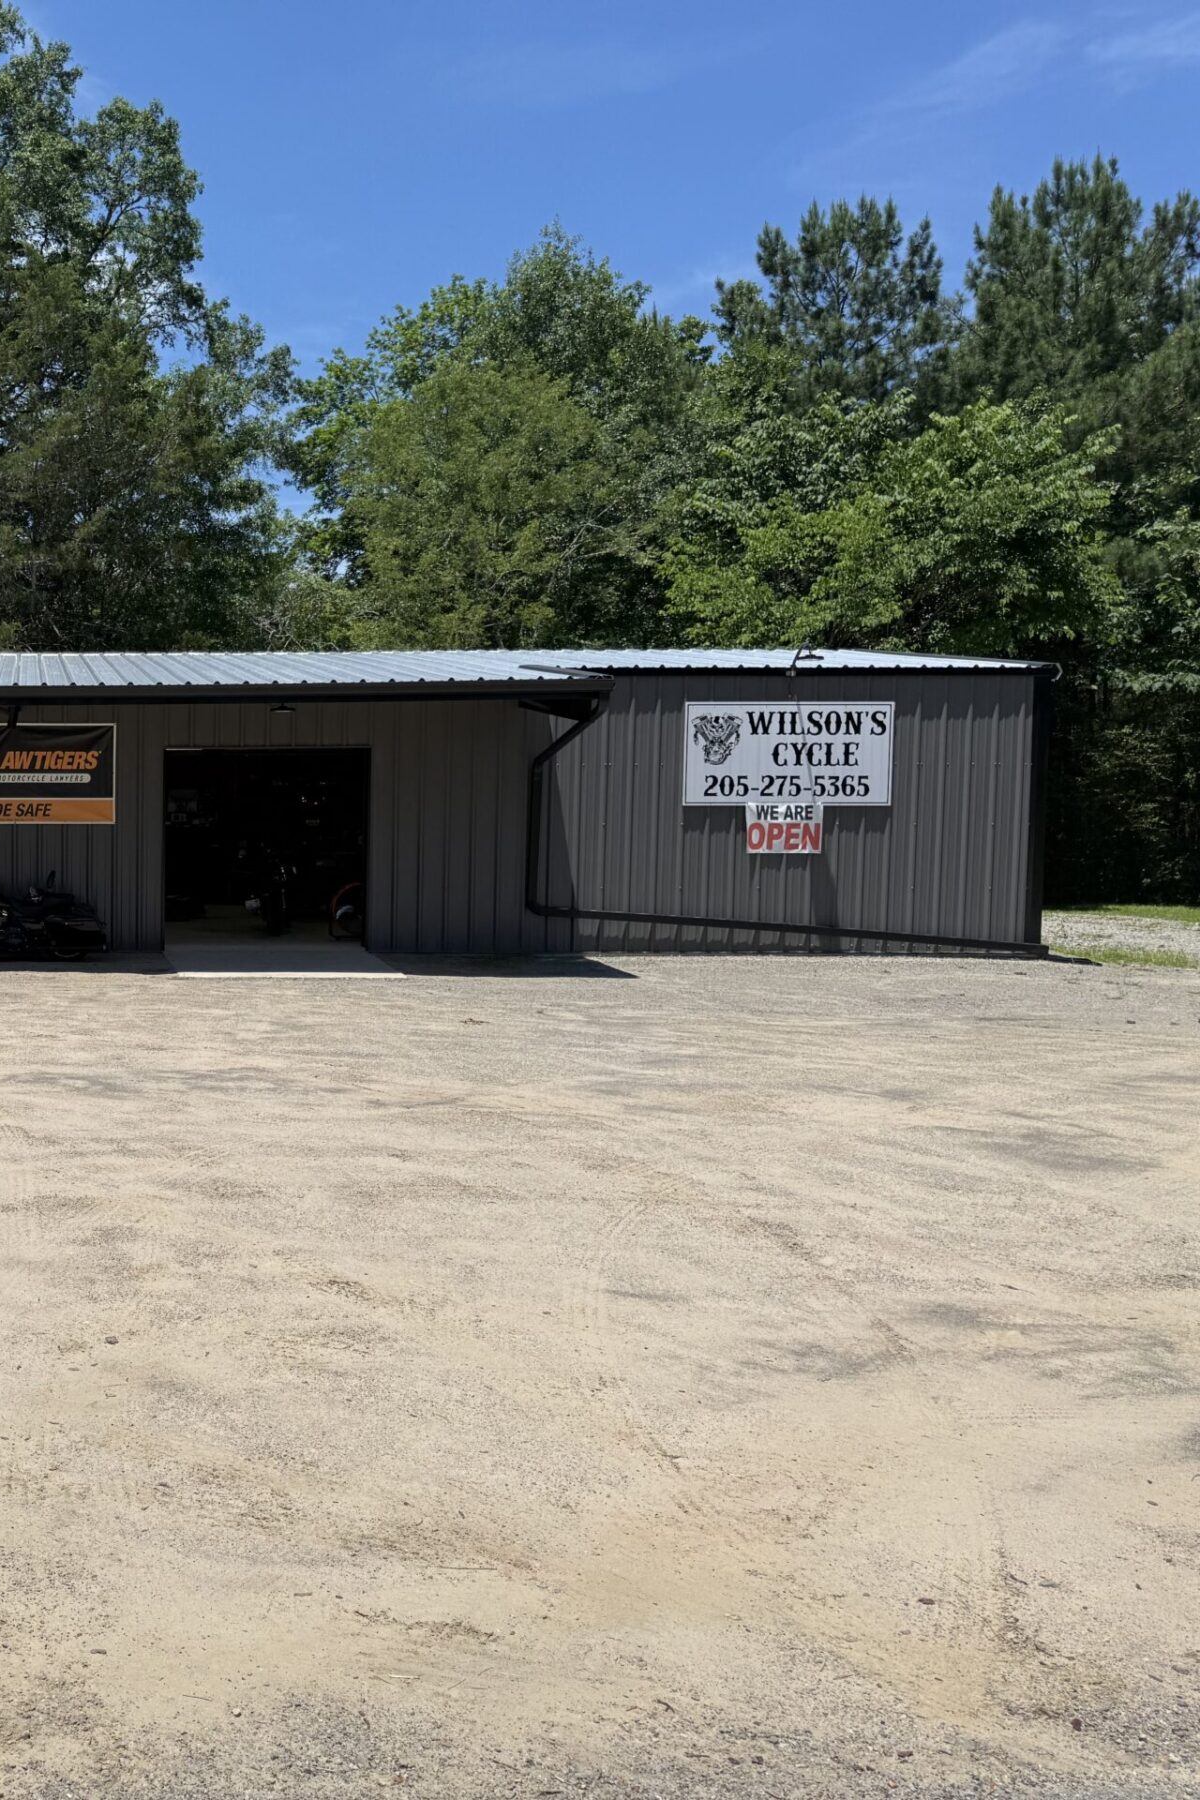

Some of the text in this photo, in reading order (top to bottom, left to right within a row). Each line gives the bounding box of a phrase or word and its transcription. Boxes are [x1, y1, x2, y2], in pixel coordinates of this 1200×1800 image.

[746, 711, 887, 736] WILSON'S
[771, 742, 860, 767] CYCLE
[703, 775, 870, 797] 205-275-5365
[15, 803, 53, 817] SAFE
[756, 805, 813, 821] WE ARE
[747, 822, 821, 851] OPEN
